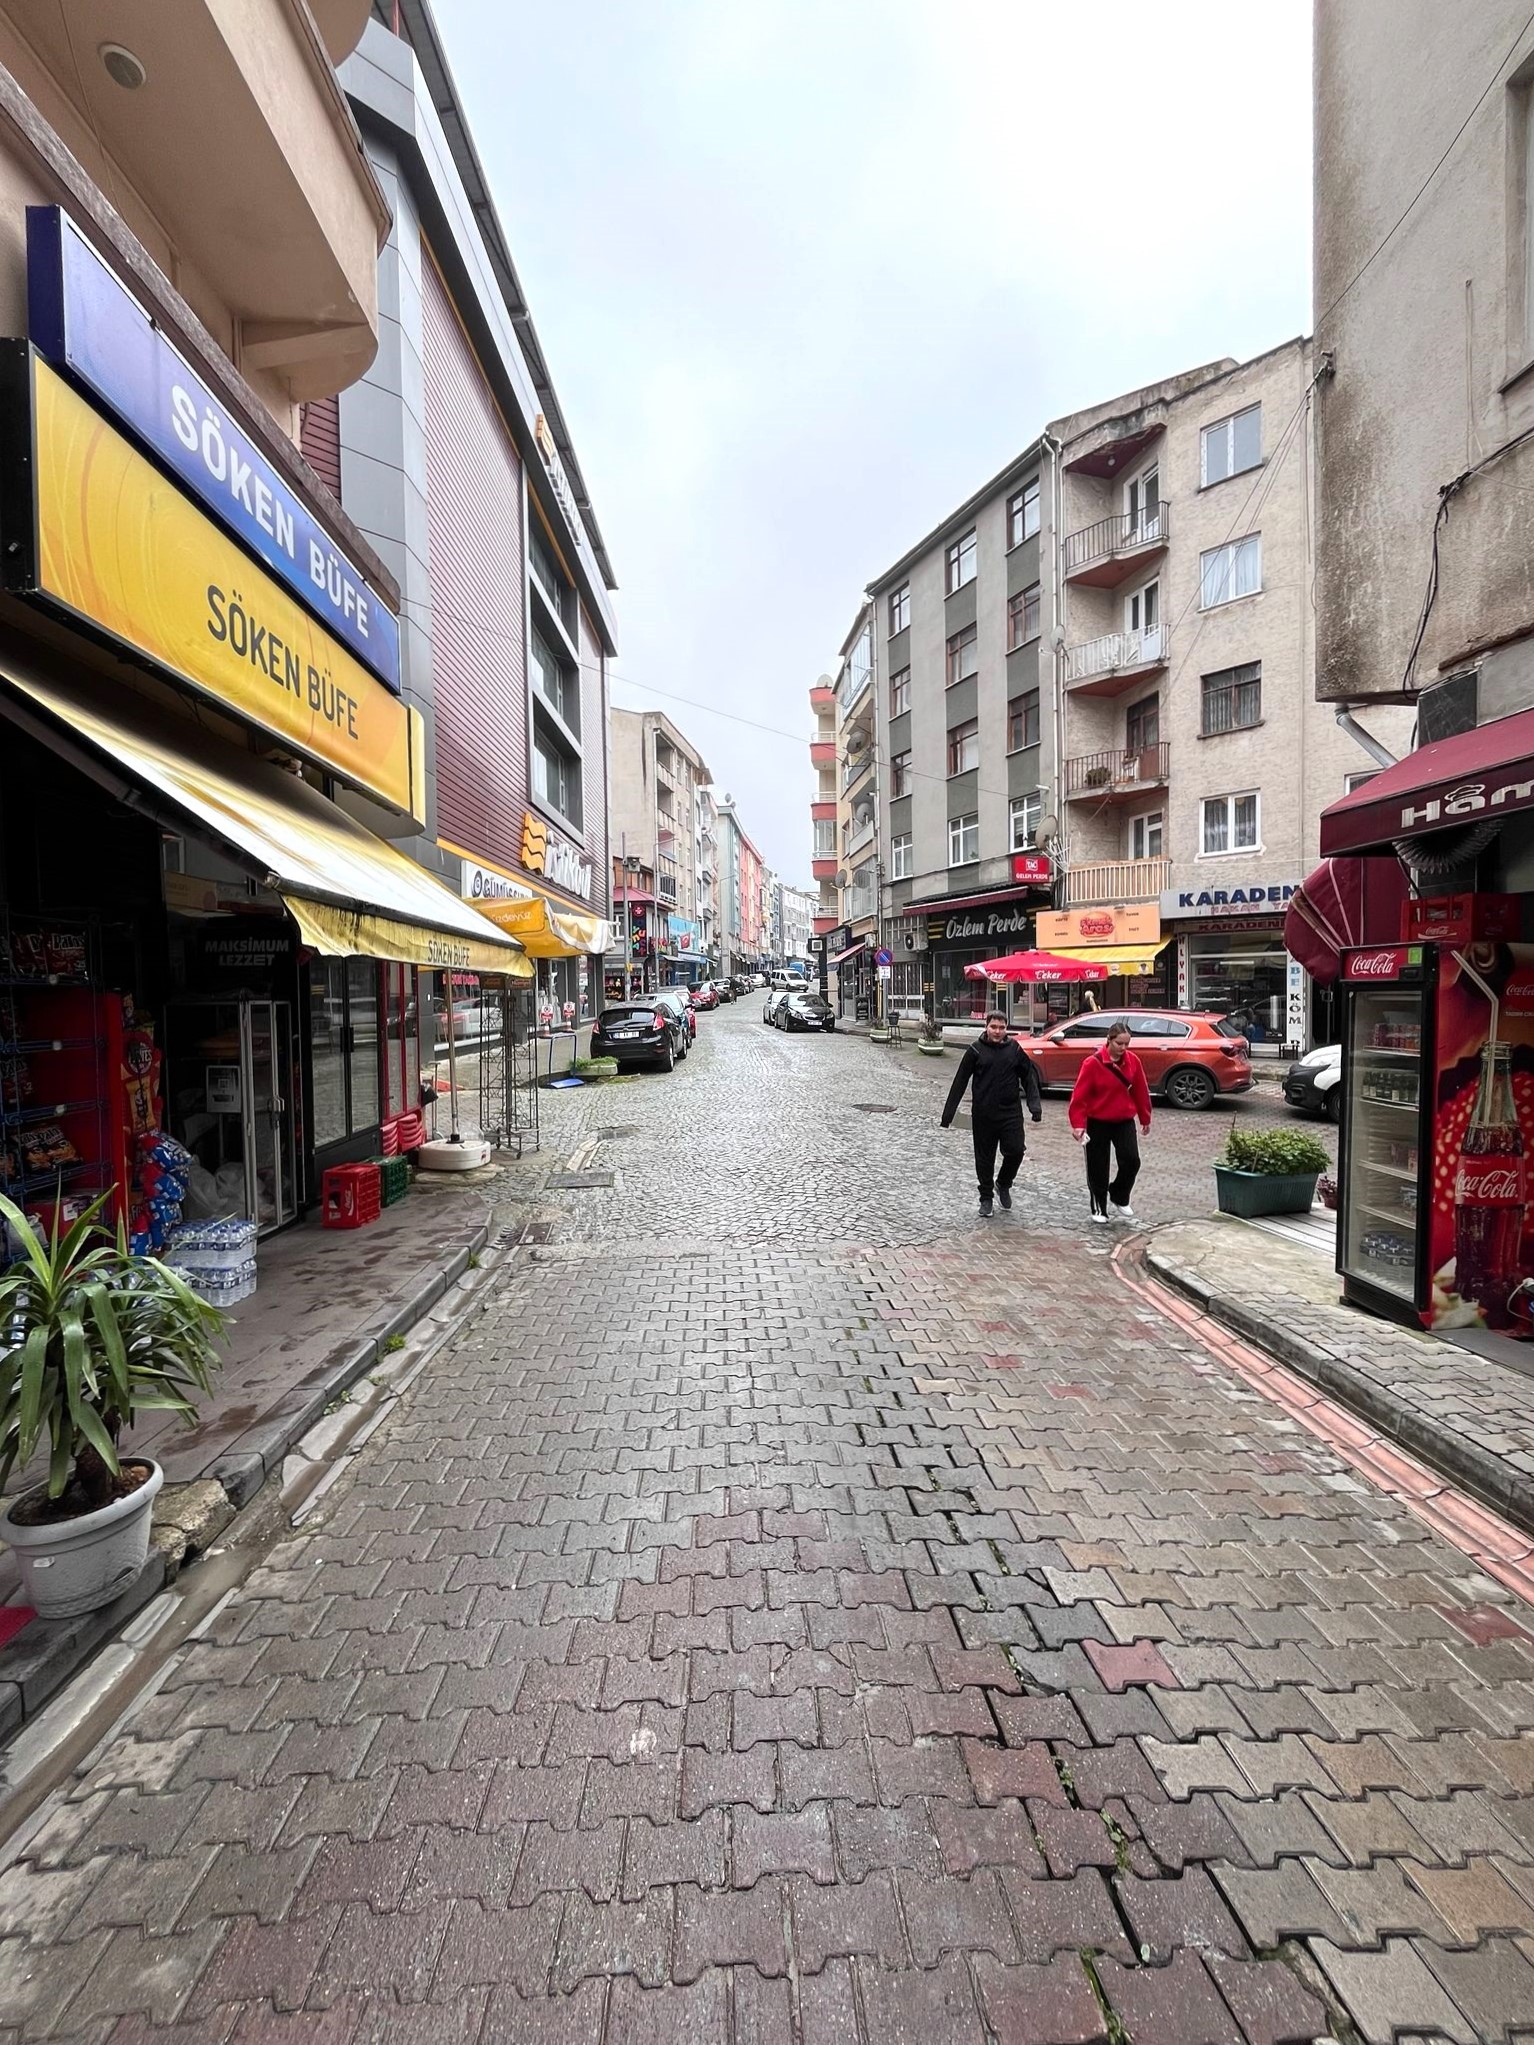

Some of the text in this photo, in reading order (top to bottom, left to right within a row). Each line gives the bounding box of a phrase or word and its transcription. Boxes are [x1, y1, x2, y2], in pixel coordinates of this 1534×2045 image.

[171, 384, 369, 639] SÖKEN BÜFE
[207, 584, 360, 741] SÖKEN BÜFE
[946, 908, 1027, 939] Özlem Perde
[205, 936, 289, 953] MAKSİMUM
[219, 954, 275, 967] LEZZET
[1352, 953, 1396, 975] Coca-Cola
[1455, 1169, 1519, 1198] Coca-Cola
